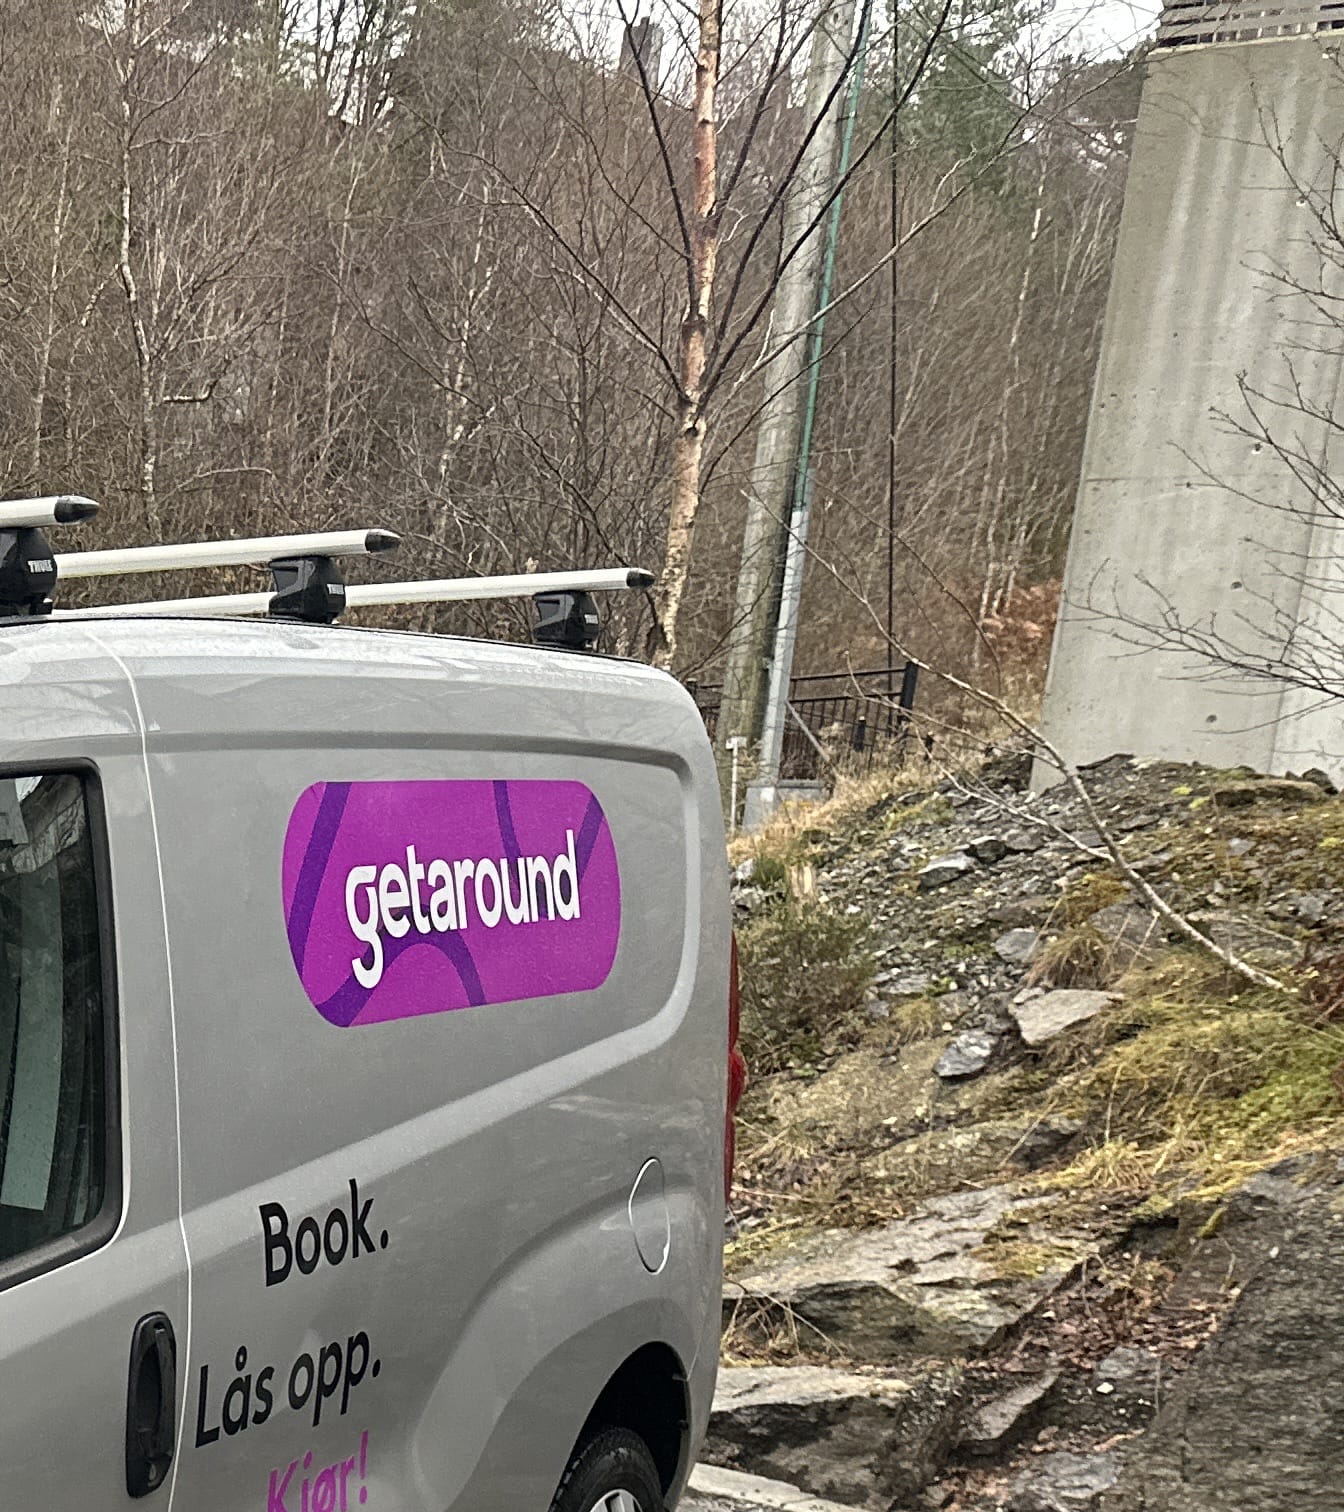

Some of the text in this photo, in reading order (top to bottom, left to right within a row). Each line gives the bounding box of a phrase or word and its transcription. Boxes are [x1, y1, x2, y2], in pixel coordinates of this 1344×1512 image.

[344, 828, 582, 990] getaround
[258, 1177, 390, 1288] Book.
[194, 1330, 382, 1449] Lås opp.
